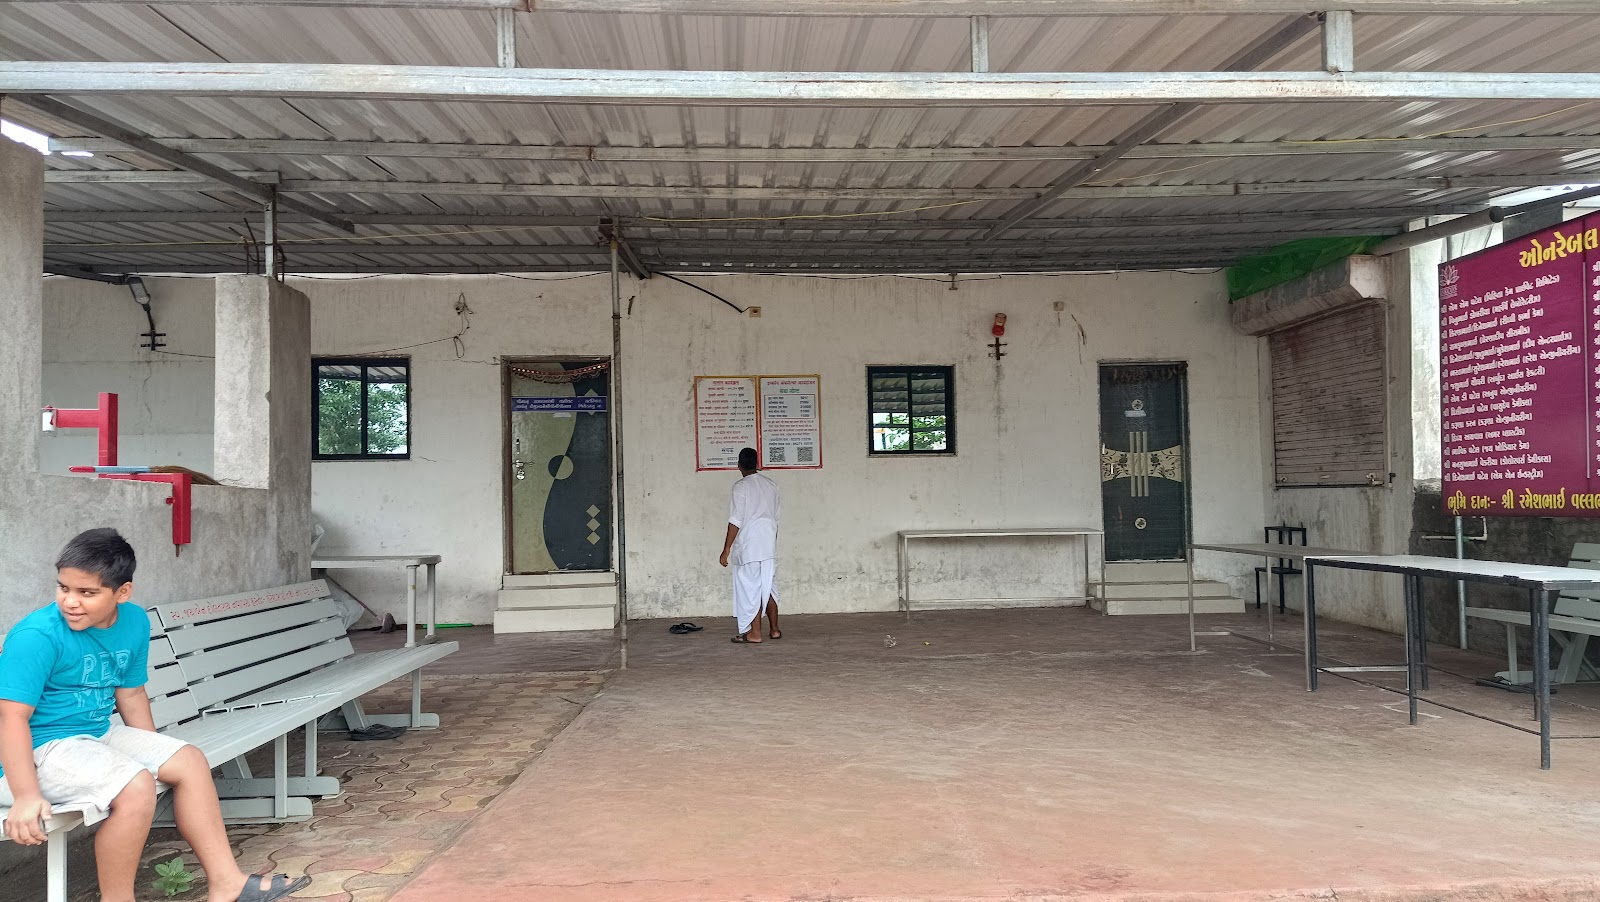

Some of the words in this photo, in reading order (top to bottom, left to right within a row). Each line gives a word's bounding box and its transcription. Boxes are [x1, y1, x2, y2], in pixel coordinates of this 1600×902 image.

[1518, 227, 1599, 267] ઓનરેબલ
[1468, 390, 1480, 399] પટેલ
[1476, 402, 1488, 412] પટેલ
[1468, 444, 1479, 453] પટેલ
[1476, 470, 1488, 480] પટેલ
[1447, 490, 1467, 516] ભૂમિ
[1501, 488, 1514, 509] શ્રી
[1519, 486, 1566, 509] રમેશભાઈ
